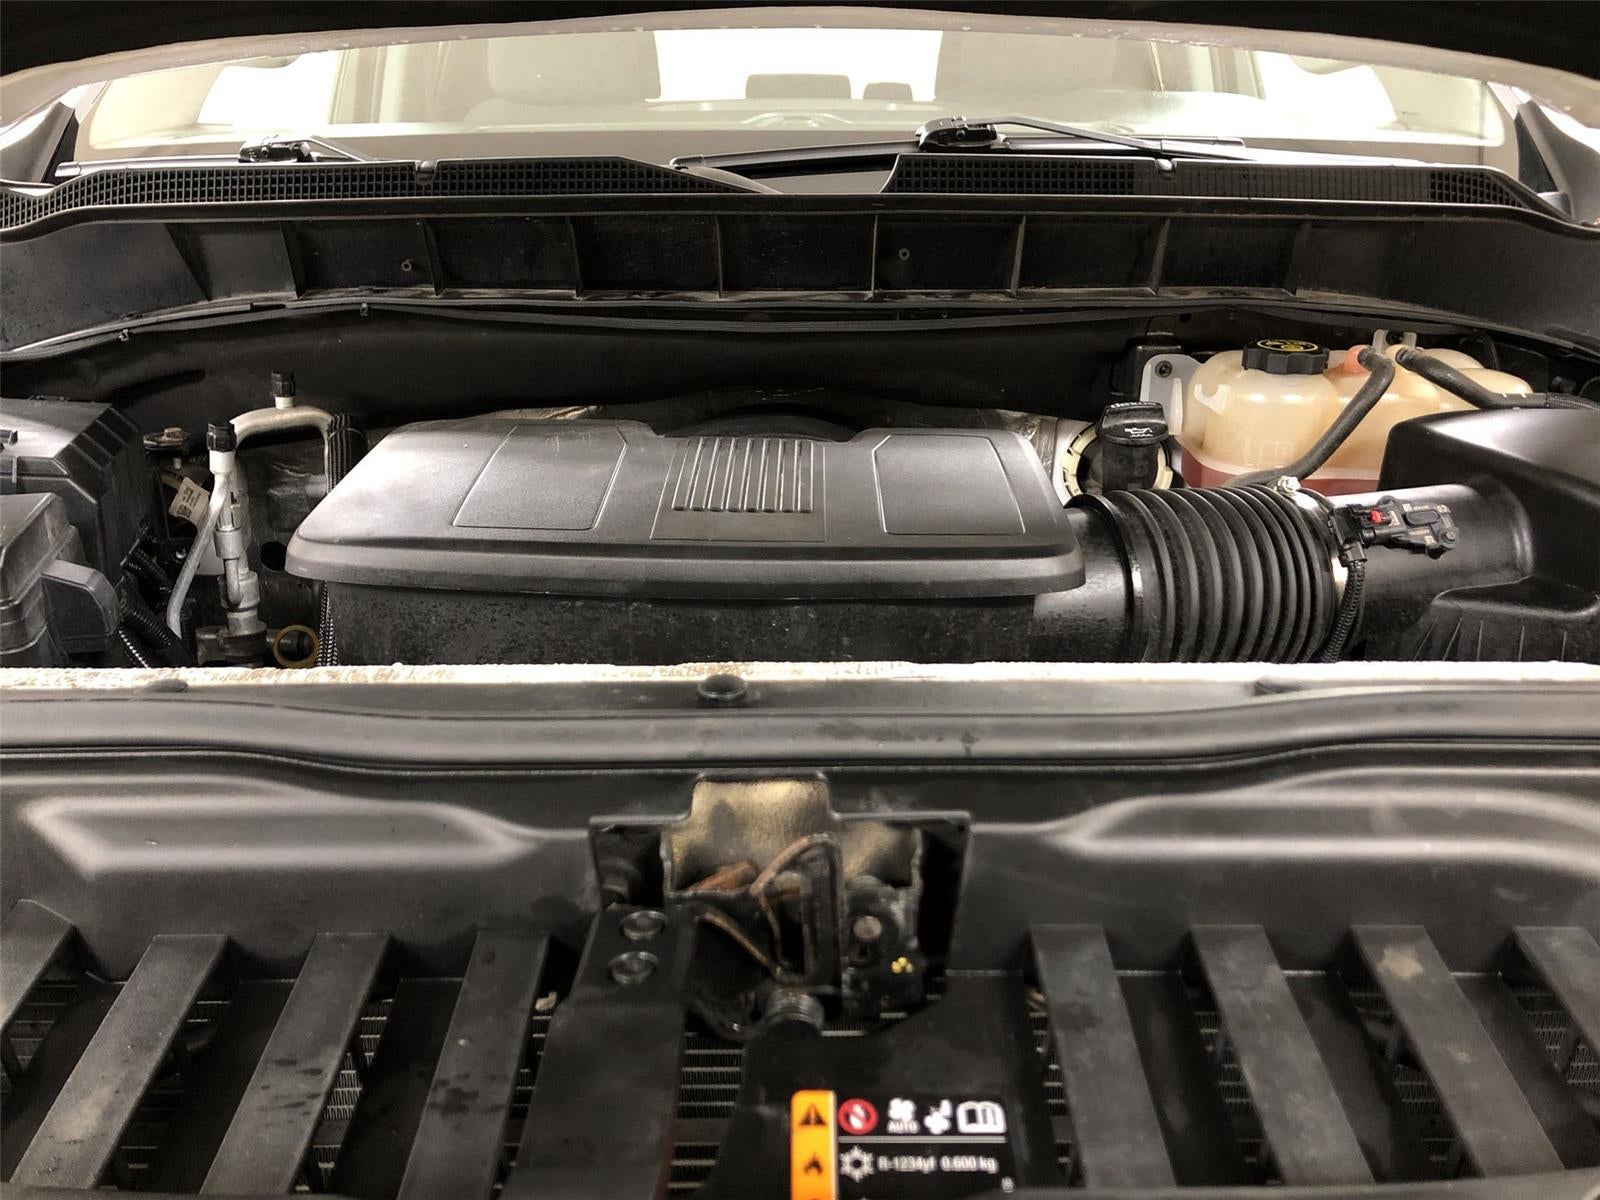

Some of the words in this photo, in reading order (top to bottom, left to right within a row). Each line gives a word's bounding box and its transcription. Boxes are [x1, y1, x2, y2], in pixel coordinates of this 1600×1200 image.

[887, 1120, 919, 1133] AUTO
[940, 1155, 977, 1172] 0.600
[979, 1155, 998, 1174] kg
